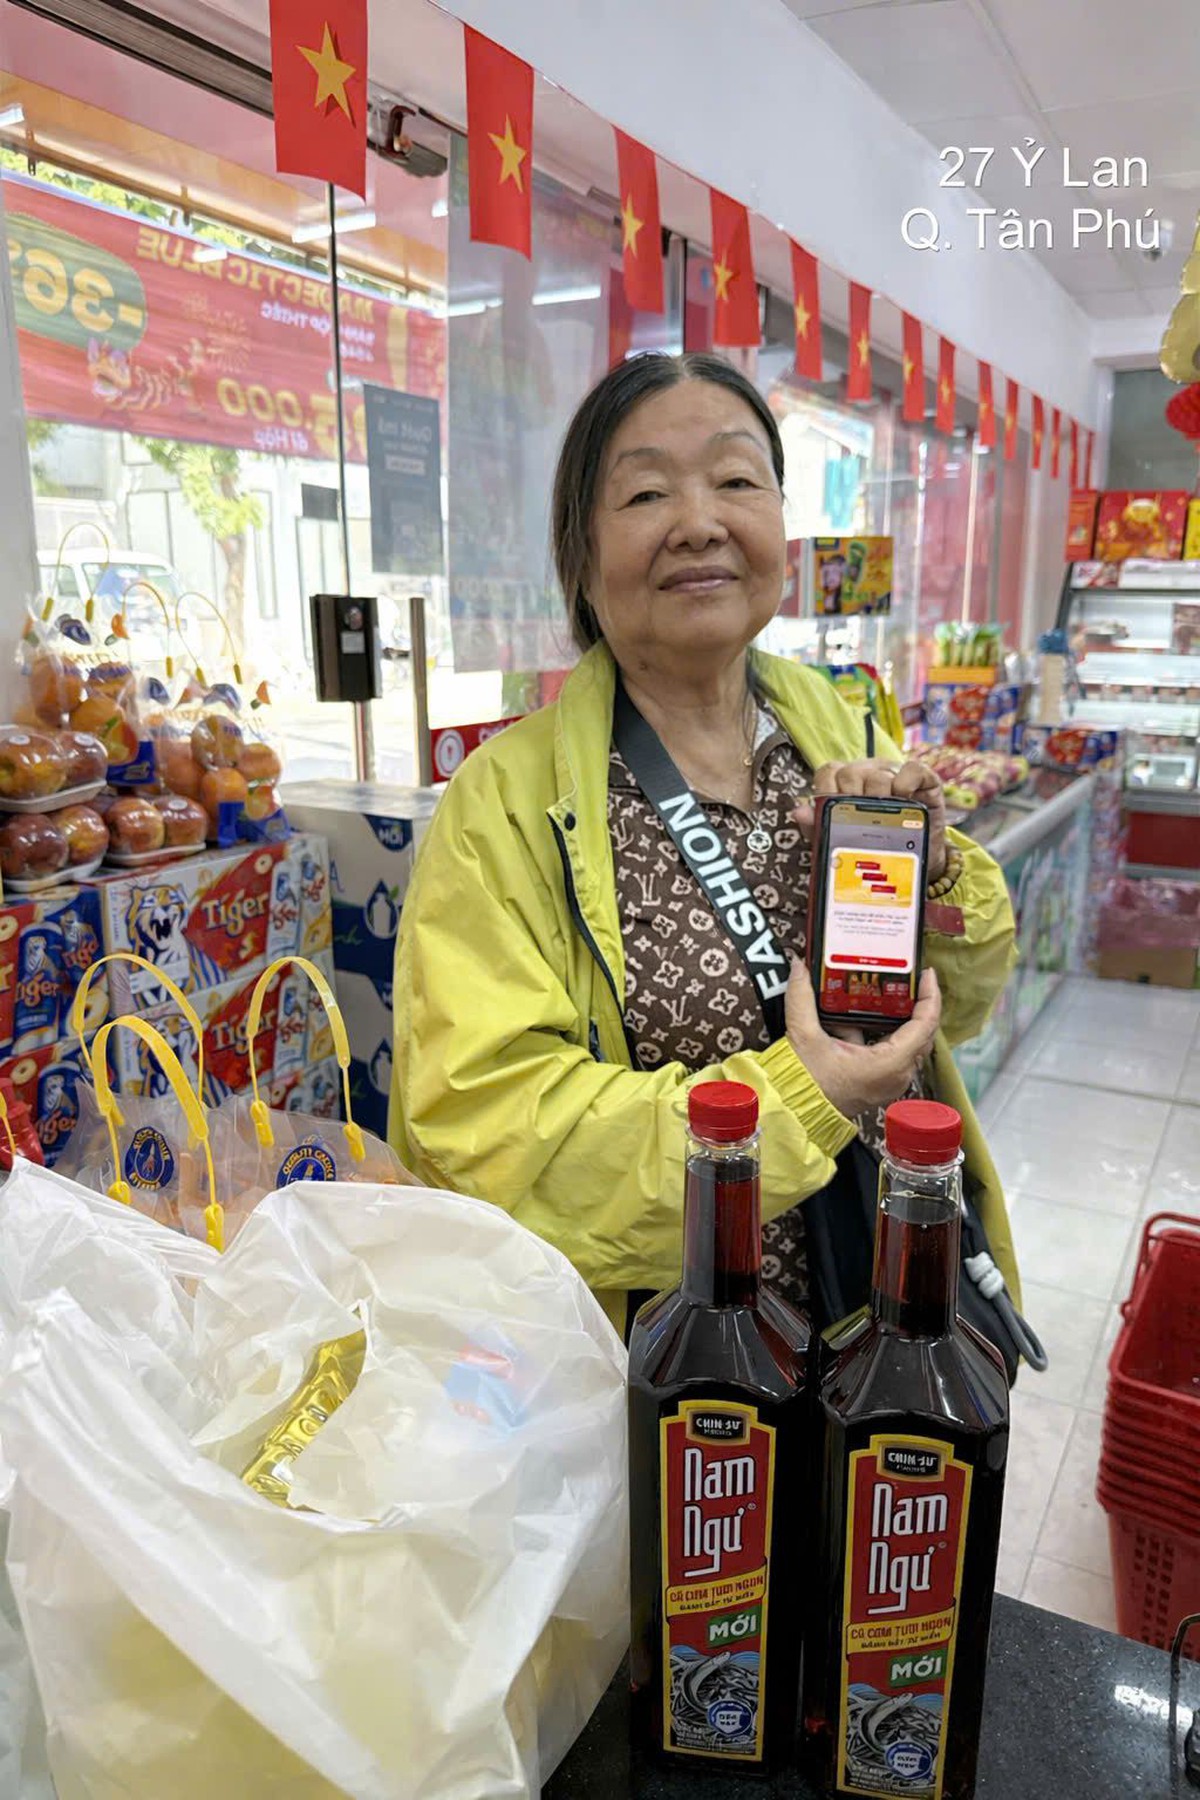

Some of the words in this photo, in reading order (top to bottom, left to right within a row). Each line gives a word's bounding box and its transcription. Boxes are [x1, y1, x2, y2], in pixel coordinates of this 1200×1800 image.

[202, 888, 269, 938] Tiger
[659, 793, 787, 1000] FASHION
[709, 1613, 758, 1642] MỚI
[891, 1655, 943, 1681] MỚI
